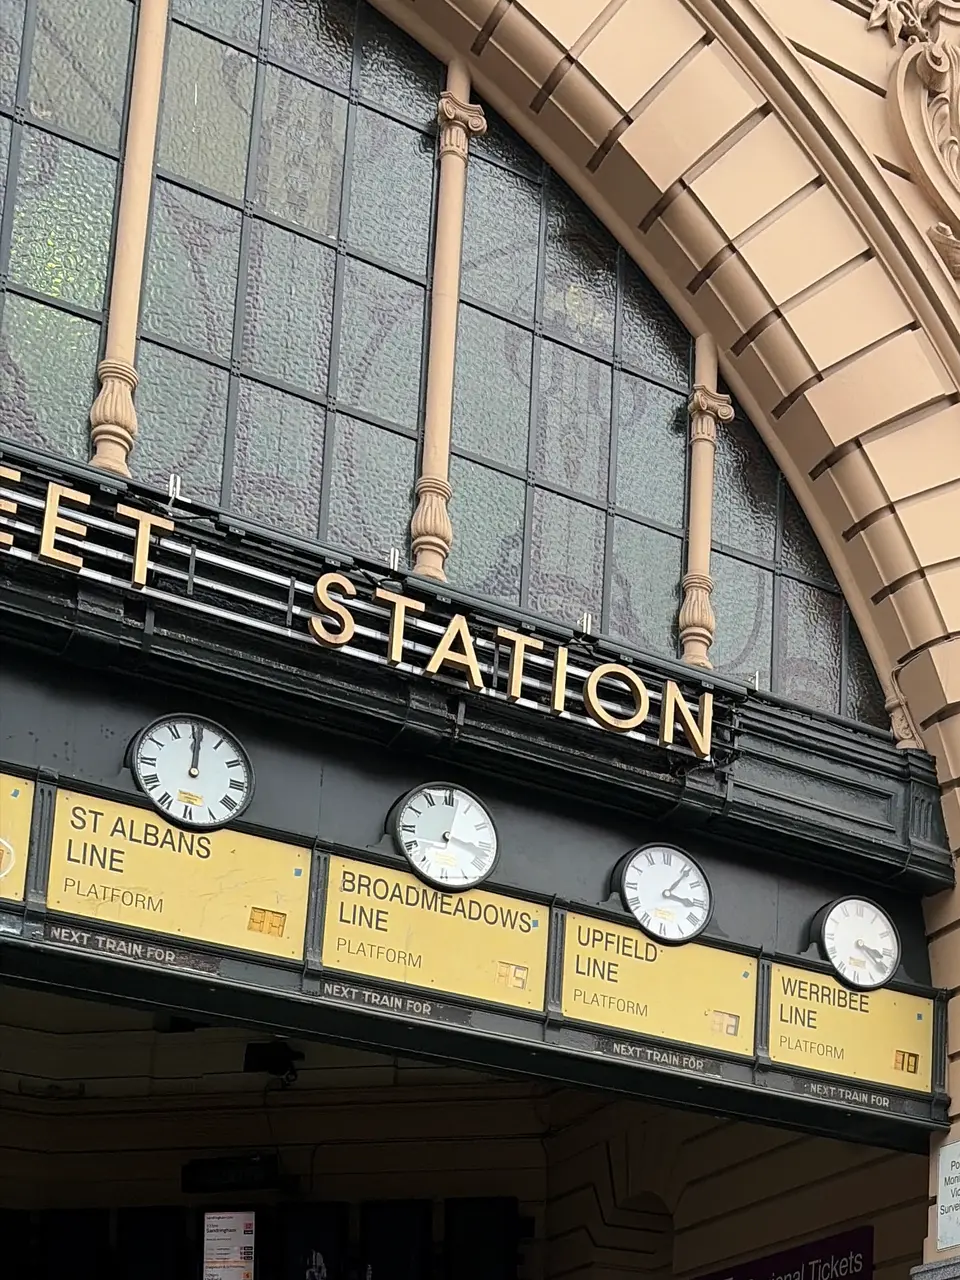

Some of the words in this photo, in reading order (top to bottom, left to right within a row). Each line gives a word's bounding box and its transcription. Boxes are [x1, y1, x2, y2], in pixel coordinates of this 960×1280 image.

[308, 572, 713, 760] STATION
[70, 806, 104, 833] ST
[110, 817, 212, 860] ALBANS
[67, 839, 125, 873] LINE
[63, 877, 164, 913] PLATFORM
[342, 871, 532, 933] BROADMEADOWS
[339, 901, 389, 932] LINE
[51, 926, 91, 946] NEXT
[95, 936, 143, 957] TRAIN
[147, 948, 176, 962] FOR
[336, 938, 423, 969] PLATFORM
[577, 925, 658, 963] UPFIELD
[575, 954, 619, 983] LINE
[324, 983, 358, 1000] NEXT
[362, 991, 402, 1011] TRAIN
[406, 1000, 432, 1016] FOR
[574, 989, 648, 1017] PLATFORM
[781, 976, 870, 1014] WERRIBEE
[779, 1003, 818, 1030] LINE
[613, 1042, 642, 1058] NEXT
[645, 1049, 679, 1067] TRAIN
[682, 1057, 704, 1071] FOR
[779, 1035, 845, 1060] PLATFORM
[810, 1083, 836, 1096] NEXT
[838, 1088, 868, 1104] TRAIN
[871, 1095, 890, 1108] FOR
